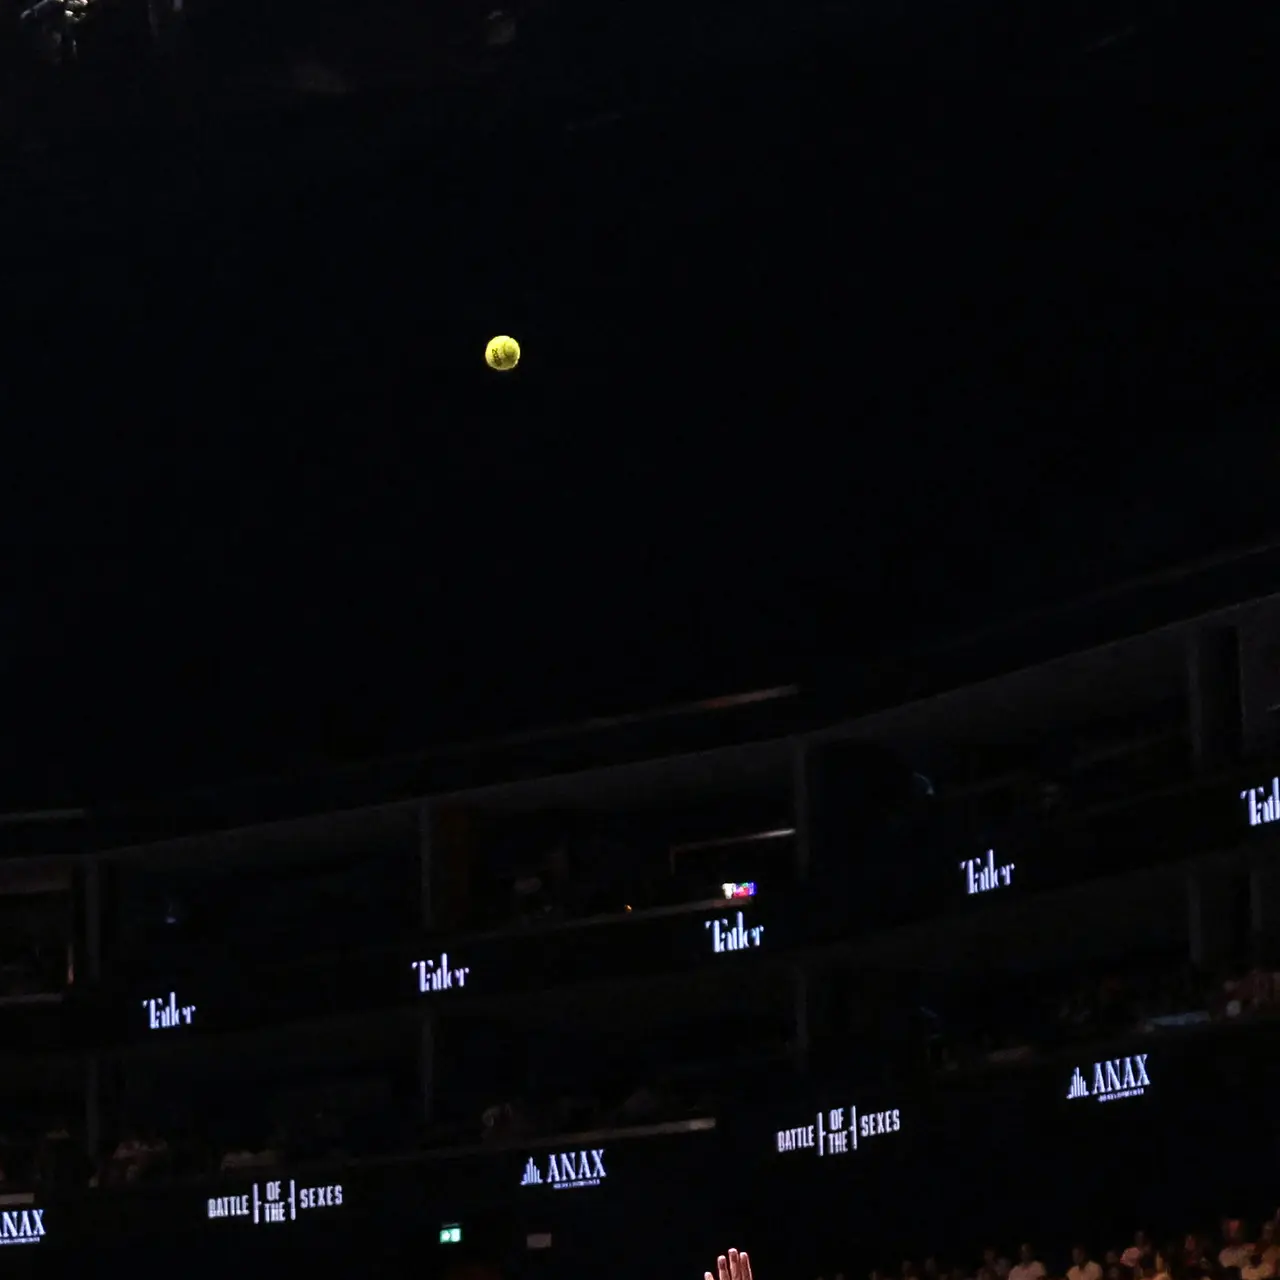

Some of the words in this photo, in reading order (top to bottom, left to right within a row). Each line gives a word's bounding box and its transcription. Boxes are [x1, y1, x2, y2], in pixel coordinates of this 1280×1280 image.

[961, 849, 1015, 894] Tatler
[705, 912, 764, 952] Tatler
[412, 953, 469, 992] Tatler
[143, 992, 196, 1029] Tatler
[1091, 1053, 1151, 1094] ANAX
[828, 1107, 845, 1131] OF
[860, 1108, 901, 1138] SEXES
[776, 1125, 815, 1153] BATTLE
[827, 1131, 849, 1154] THE
[544, 1148, 607, 1183] ANAX
[265, 1181, 282, 1201] OF
[299, 1185, 342, 1210] SEXES
[207, 1195, 250, 1219] BATTLE
[263, 1201, 286, 1222] THE
